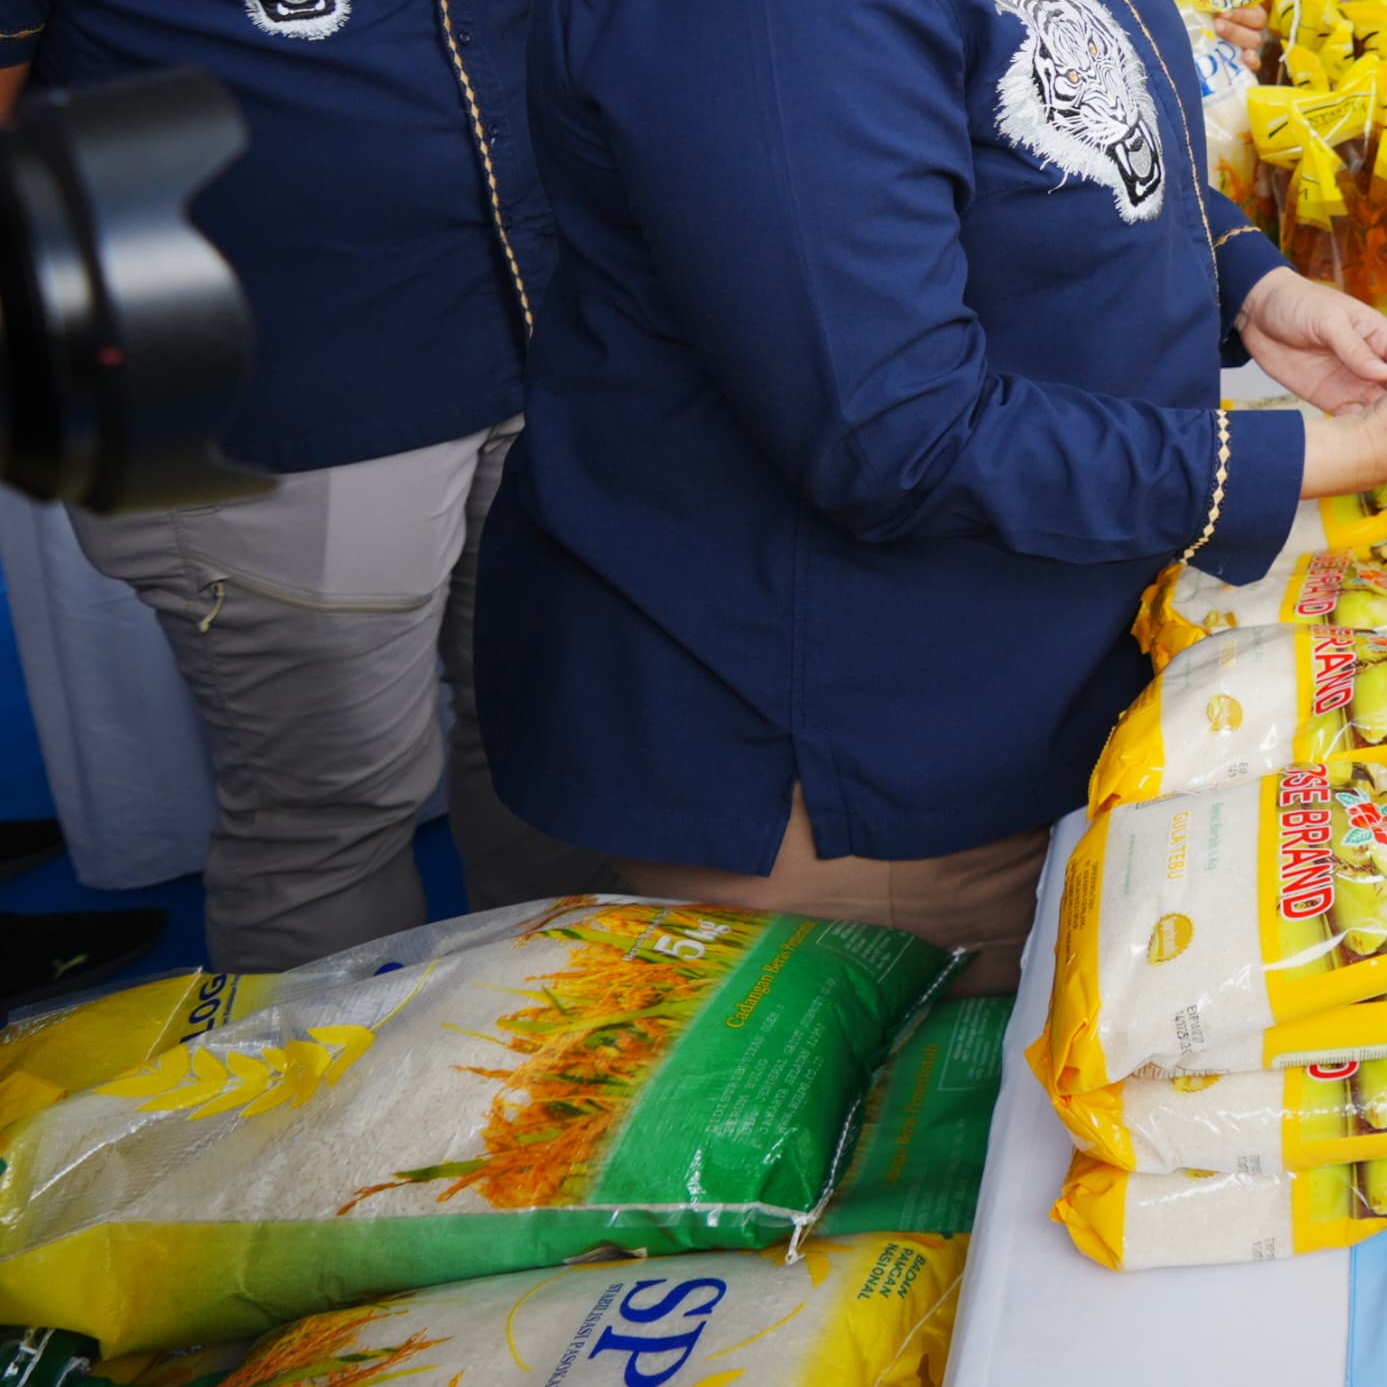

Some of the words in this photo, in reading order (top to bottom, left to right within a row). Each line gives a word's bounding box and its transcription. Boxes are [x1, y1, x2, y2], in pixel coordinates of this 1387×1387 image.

[1170, 810, 1190, 848] GULA
[1166, 847, 1188, 882] TEBU
[1280, 808, 1335, 922] BRAND
[654, 934, 706, 961] 5
[725, 970, 774, 1030] Cadangan
[856, 1242, 898, 1302] NASIONAL
[879, 1248, 915, 1299] PANGAN
[572, 1282, 624, 1342] STABILISASI
